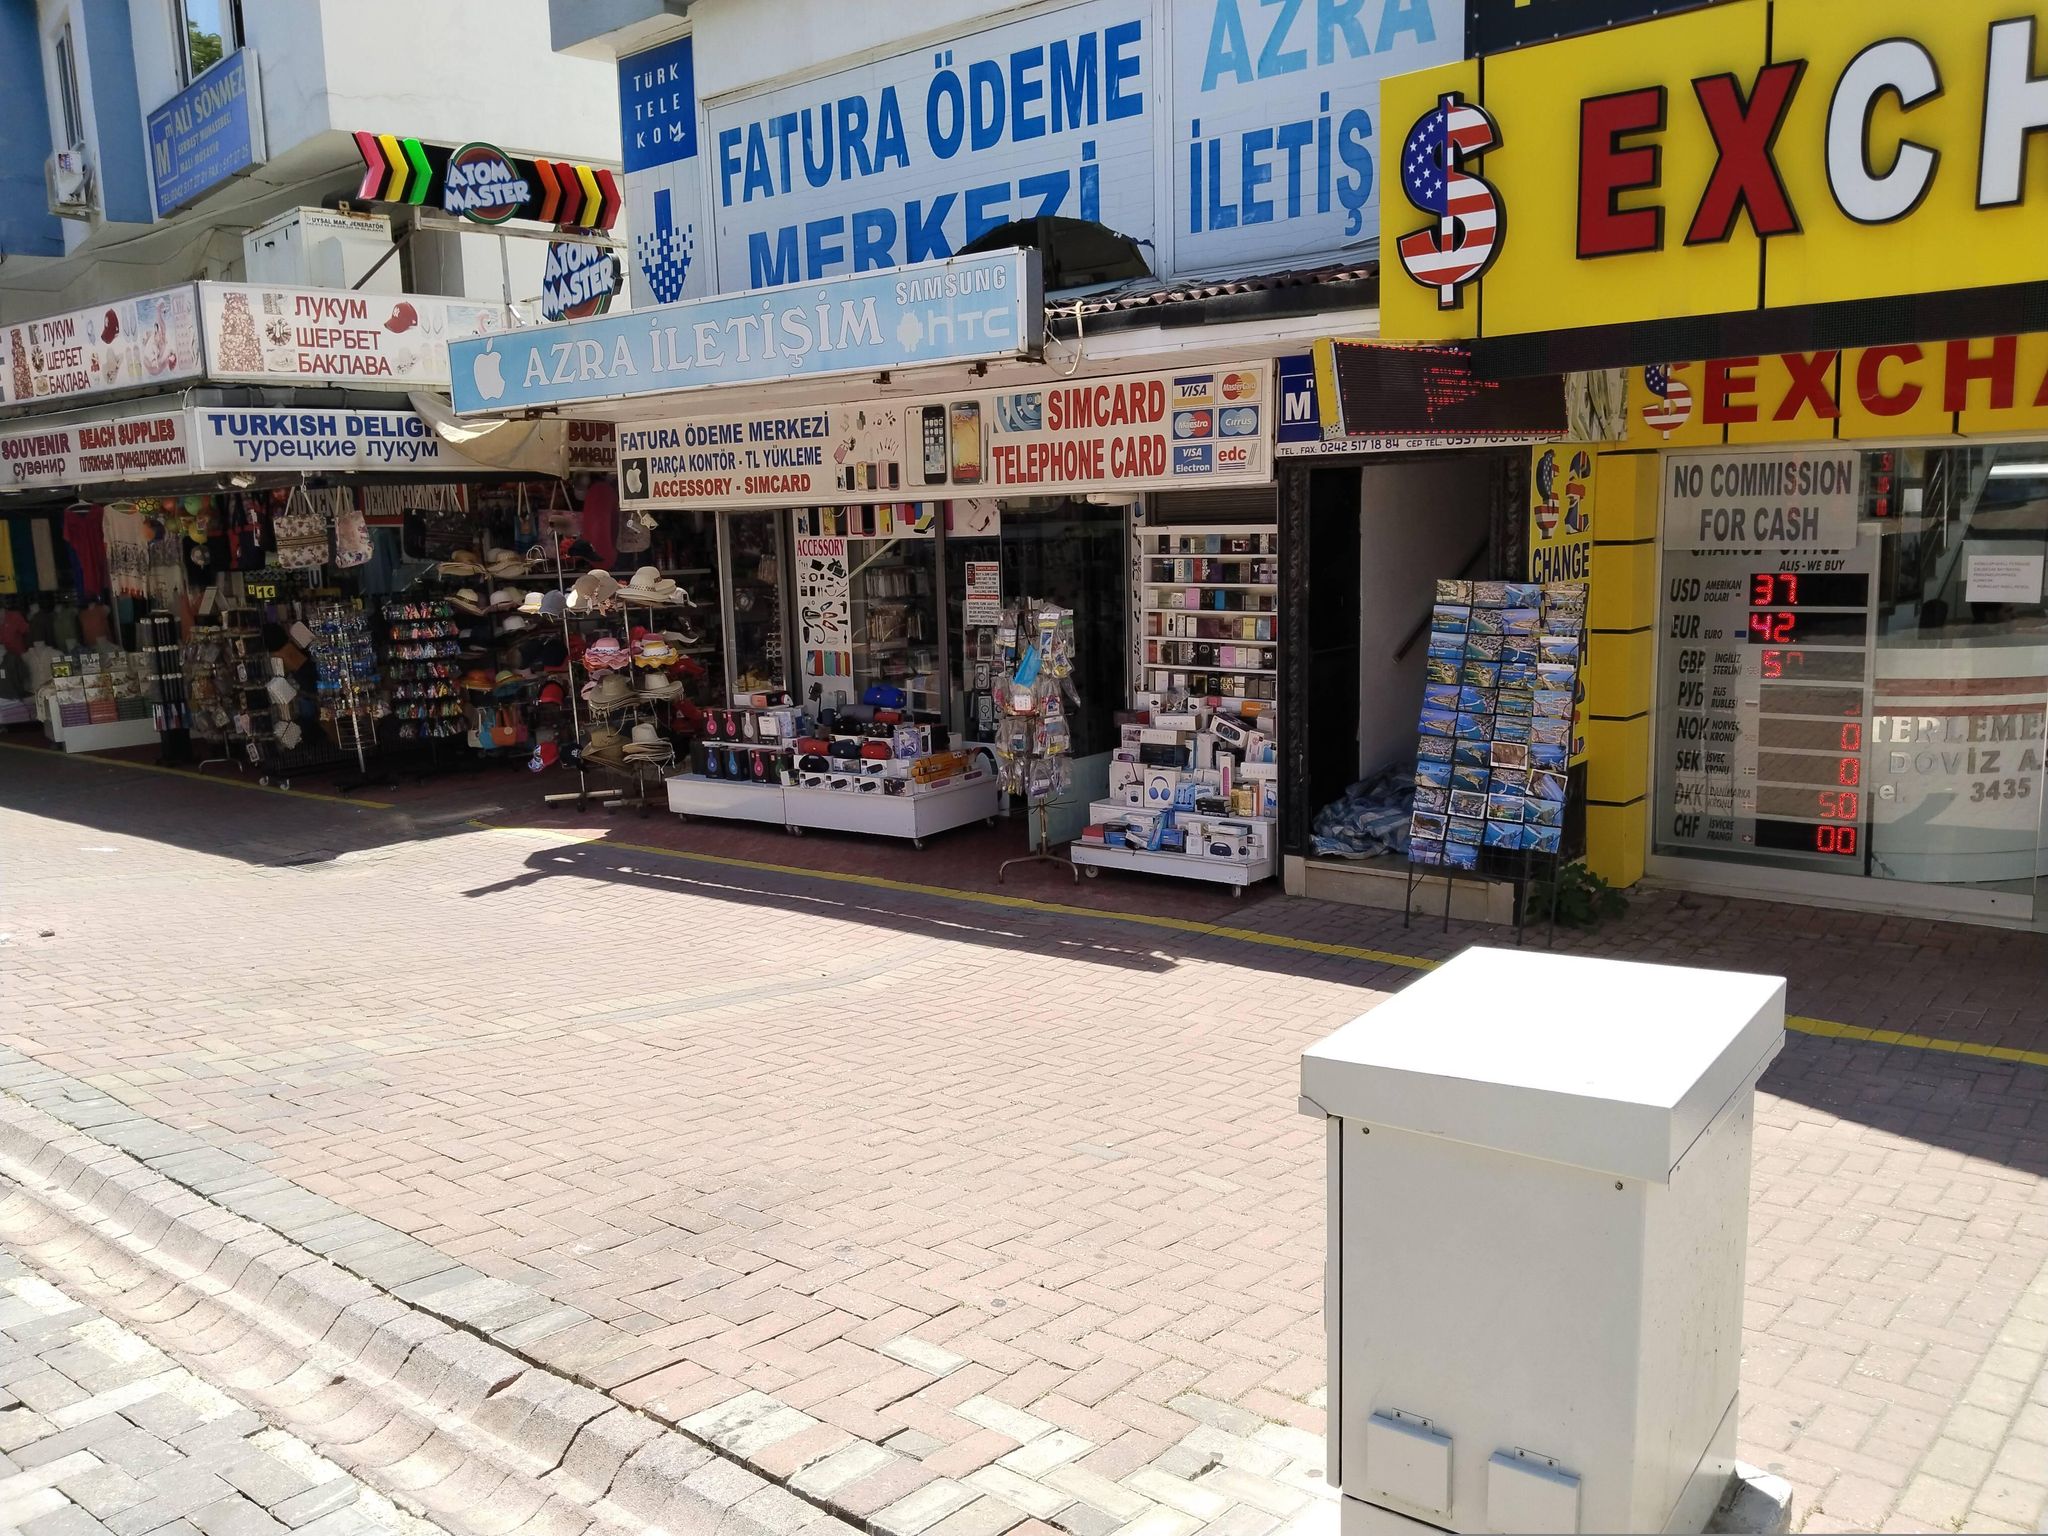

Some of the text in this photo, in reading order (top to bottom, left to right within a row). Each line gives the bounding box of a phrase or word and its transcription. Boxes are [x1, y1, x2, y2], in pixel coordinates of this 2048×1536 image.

[633, 62, 679, 92] TÜRK
[194, 64, 246, 125] SÖNMEZ
[634, 93, 681, 121] TELE
[719, 20, 1145, 207] FATURA ÖDEME
[636, 121, 686, 149] KOM
[447, 160, 512, 188] ATOM
[1190, 90, 1374, 237] İLETİŞ
[444, 179, 531, 214] MASTER
[311, 217, 332, 225] UYSAL
[546, 240, 598, 282] ATOM
[543, 256, 617, 320] MASTER
[896, 265, 1006, 306] SAMSUNG
[295, 296, 367, 325] ЛУКУМ
[296, 327, 381, 351] ШЕРБЕТ
[522, 292, 884, 388] AZRA İLETİŞİM
[47, 346, 82, 371] ШЕРБЕТ
[298, 352, 392, 376] БАКЛАВА
[49, 370, 91, 395] БАКЛАВА
[1181, 384, 1208, 397] VISA
[1047, 380, 1166, 431] SIMCARD
[79, 418, 176, 450] BEACH SUPPLIES
[208, 414, 337, 437] TURKISH
[620, 411, 830, 452] FATURA ÖDEME MERKEZİ
[1177, 418, 1209, 430] Maestro
[1225, 416, 1252, 427] Cirrus
[1, 433, 71, 460] SOUVENIR
[234, 440, 439, 462] турецкие лукум
[1182, 448, 1203, 458] VISA
[1218, 446, 1247, 463] edc
[1319, 441, 1347, 453] 0242
[1350, 439, 1367, 451] 517
[1370, 438, 1381, 450] 18
[1384, 438, 1399, 449] 84
[651, 453, 686, 478] PARÇA
[689, 448, 736, 473] KONTÖR
[745, 450, 761, 469] TL
[764, 445, 823, 468] YÜKLEME
[992, 434, 1166, 485] TELEPHONE CARD
[1176, 463, 1211, 474] Electron
[652, 477, 732, 498] ACCESSORY
[744, 473, 811, 495] SIMCARD
[1673, 464, 1703, 498] NO
[1710, 460, 1853, 497] COMMISSION
[1700, 507, 1819, 541] FOR CASH
[797, 538, 844, 556] ACCESSORY
[1533, 542, 1590, 583] CHANGE
[1807, 560, 1822, 571] WE
[1825, 560, 1845, 571] BUY
[1670, 578, 1700, 602] USD
[1704, 593, 1730, 602] DOLARI
[1670, 615, 1700, 639] EUR
[1704, 630, 1723, 640] EURO
[1679, 649, 1705, 674] GBP
[1676, 716, 1709, 741] NOK
[1675, 750, 1701, 772] SEK
[1970, 777, 2031, 802] 3435
[1674, 815, 1700, 837] CHF
